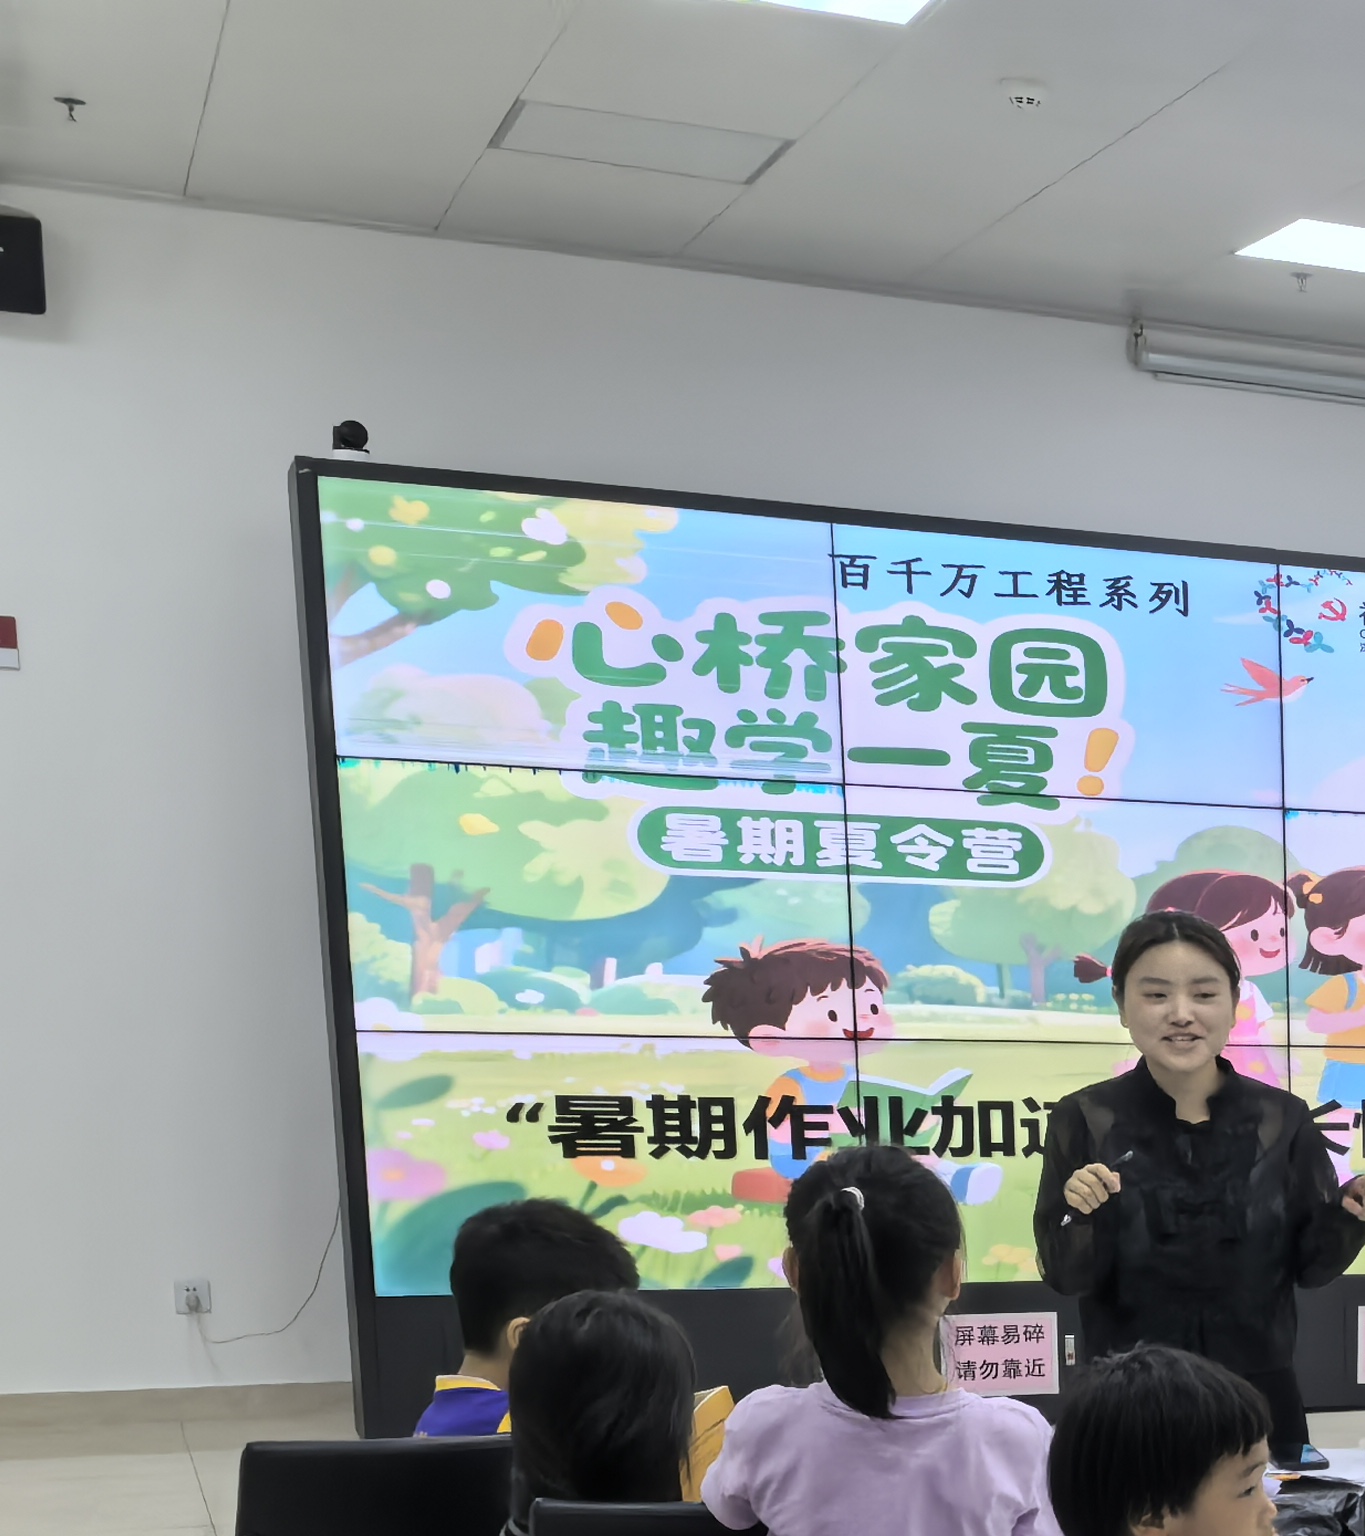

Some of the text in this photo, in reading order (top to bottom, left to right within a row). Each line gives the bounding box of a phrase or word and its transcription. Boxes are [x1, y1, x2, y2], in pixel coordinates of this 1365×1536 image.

[830, 552, 1191, 617] 百千万工程系列
[524, 601, 1108, 718] 心桥家园
[660, 813, 1025, 877] 暑期夏令营
[955, 1323, 1045, 1346] 屏幕易碎
[955, 1358, 1046, 1381] 请勿靠近
